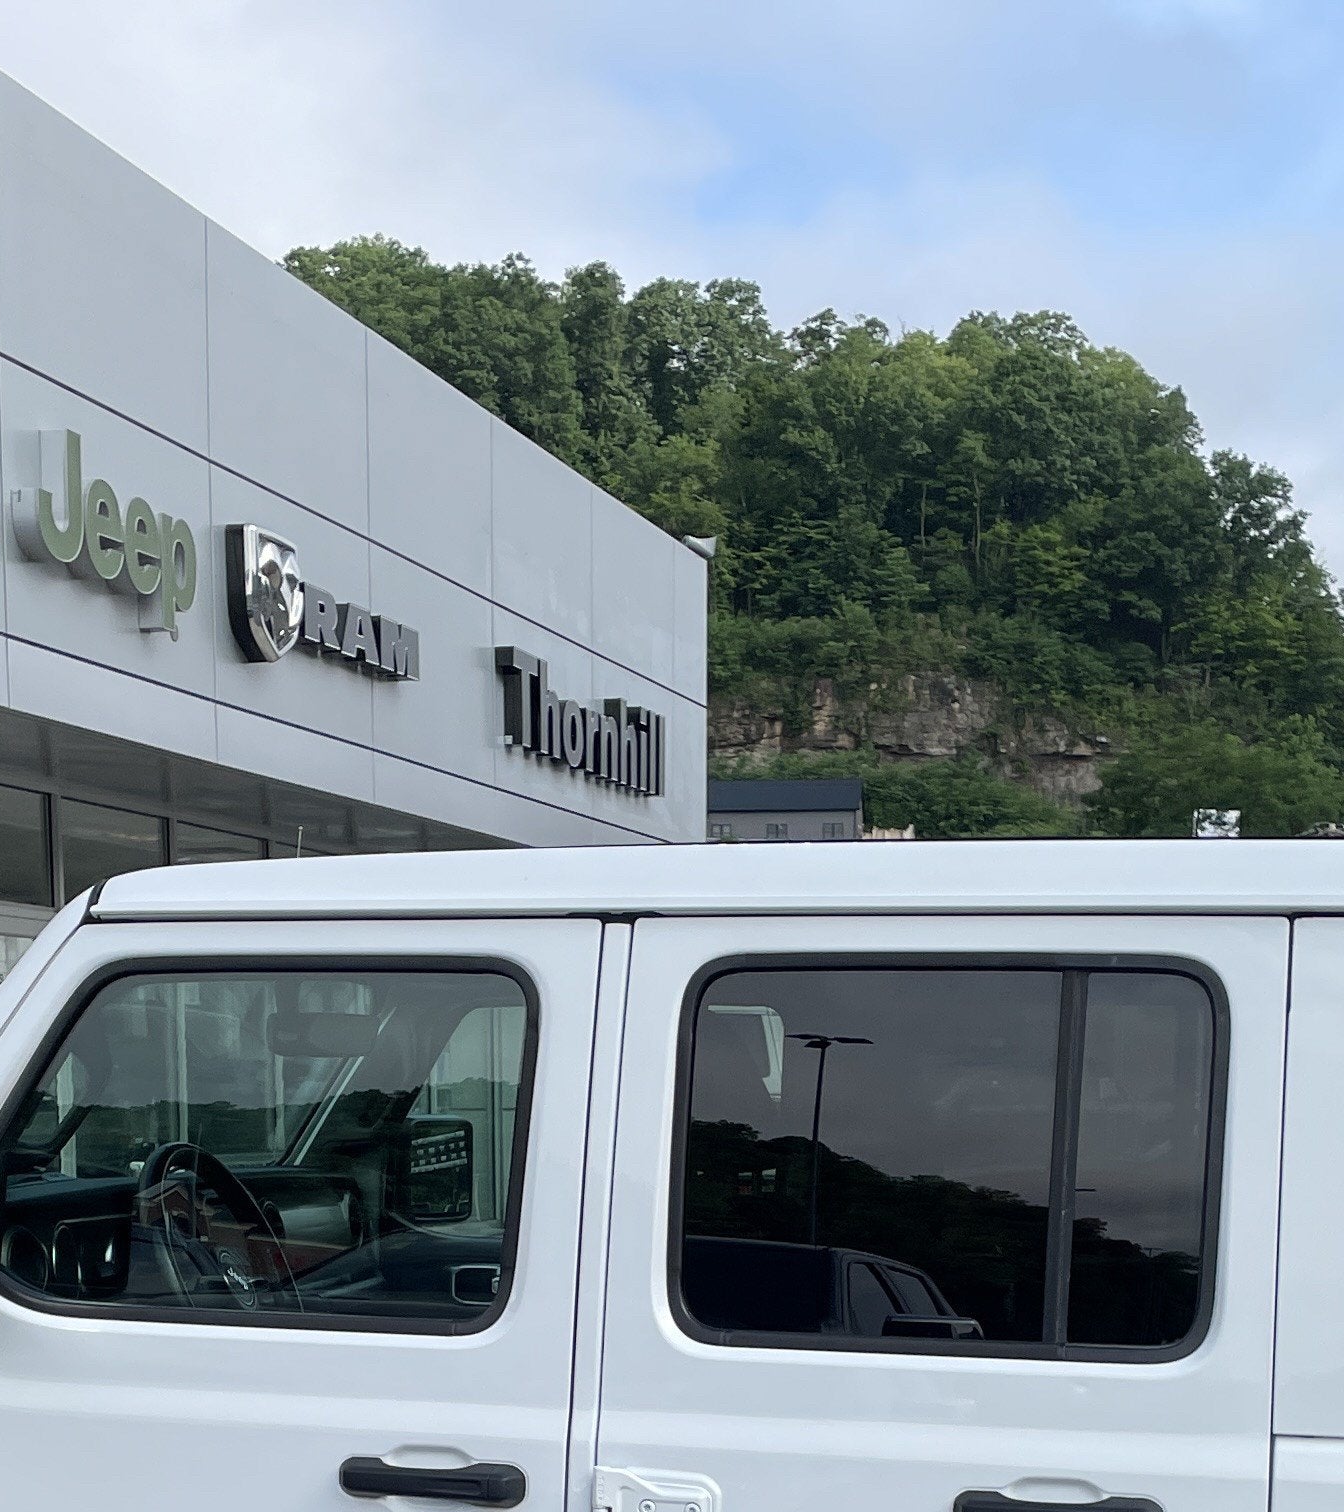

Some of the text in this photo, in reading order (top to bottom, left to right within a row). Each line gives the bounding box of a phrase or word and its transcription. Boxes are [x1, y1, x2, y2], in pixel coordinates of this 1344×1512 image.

[37, 428, 197, 632] Jeep
[303, 581, 420, 681] RAM
[510, 645, 666, 797] Thornhill
